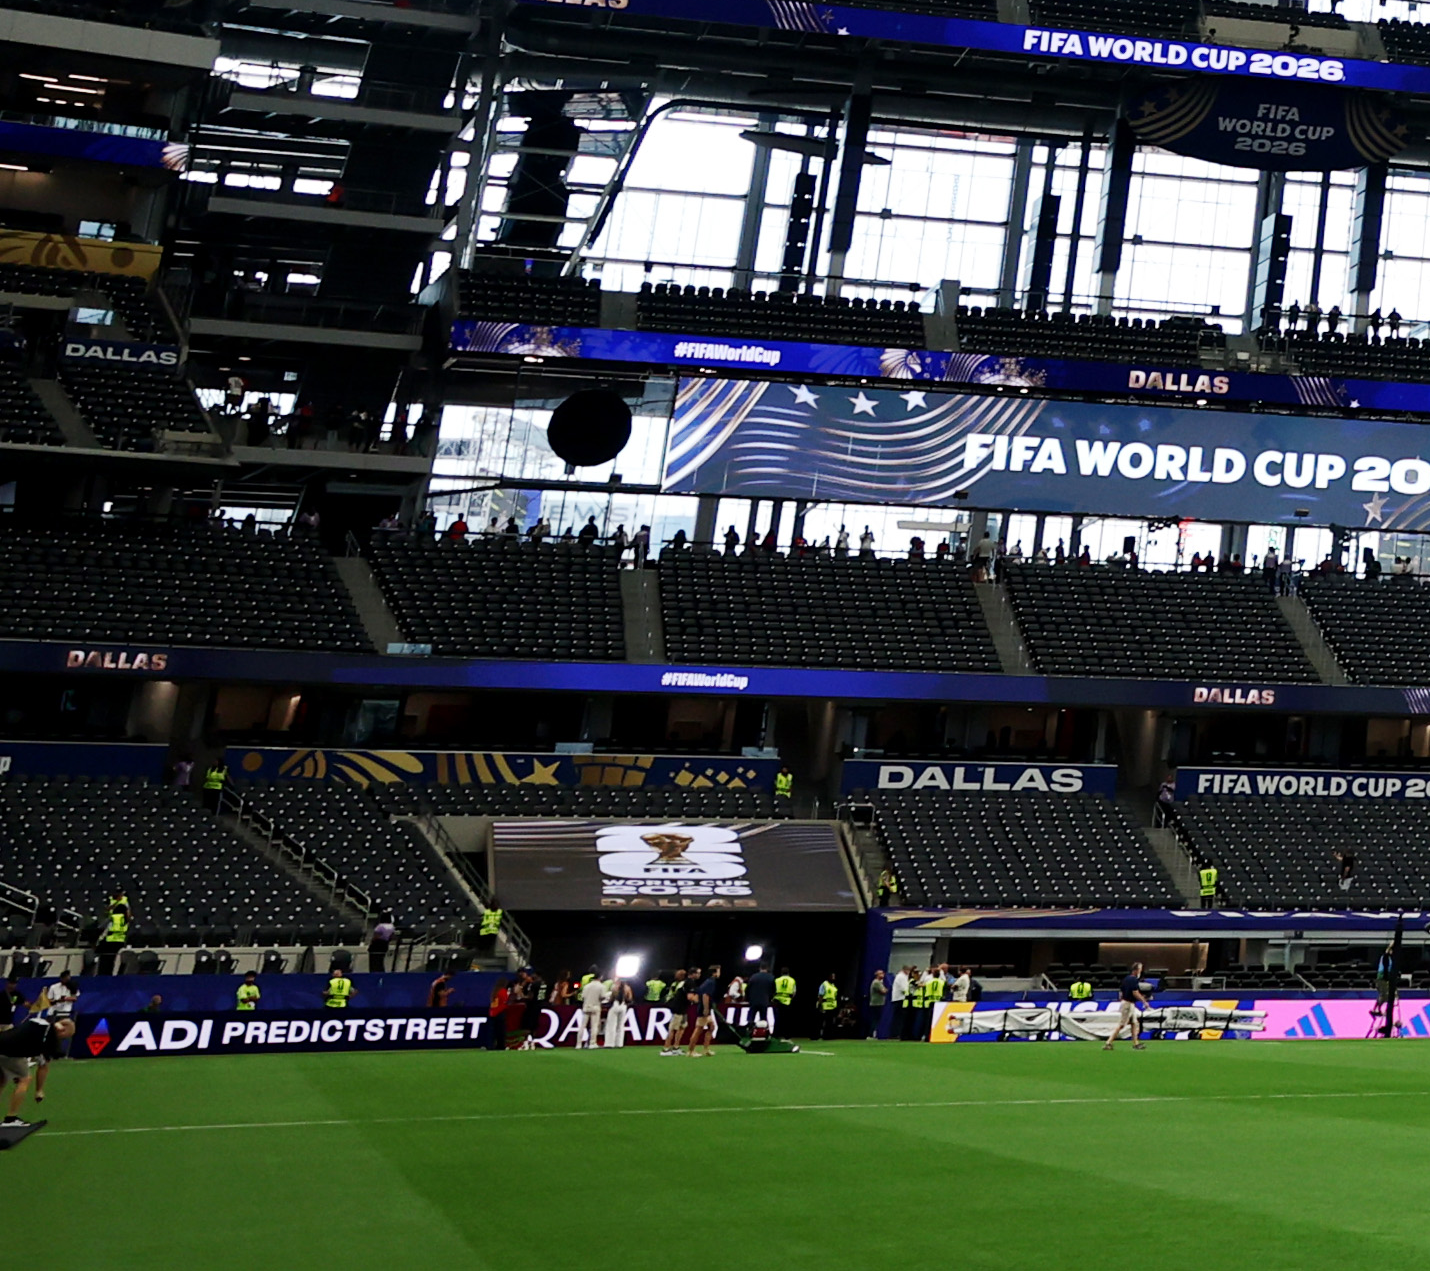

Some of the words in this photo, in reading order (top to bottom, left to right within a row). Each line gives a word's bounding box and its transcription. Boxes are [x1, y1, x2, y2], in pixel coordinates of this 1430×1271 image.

[1024, 30, 1083, 55] FIFA
[1088, 36, 1187, 64] WORLD
[1192, 46, 1246, 70] CUP
[1250, 53, 1345, 81] 2026
[1257, 104, 1299, 121] FIFA
[1219, 117, 1290, 137] WORLD
[1295, 126, 1334, 140] CUP
[1235, 137, 1306, 155] 2026
[66, 344, 177, 364] DALLAS
[674, 342, 780, 366] #FIFAWorldCup
[1129, 371, 1228, 393] DALLAS
[964, 433, 1068, 474] FIFA
[1076, 440, 1246, 483] WORLD
[1254, 451, 1346, 488] CUP
[68, 651, 167, 669] DALLAS
[662, 673, 748, 690] #FIFAWorldCup
[1194, 688, 1274, 704] DALLAS
[878, 766, 1082, 792] DALLAS
[1198, 775, 1251, 794] FIFA
[1257, 776, 1347, 795] WORLD
[1352, 778, 1401, 797] CUP
[602, 886, 752, 895] 2026
[117, 1020, 213, 1051] ADI
[222, 1017, 487, 1044] PREDICTSTREET
